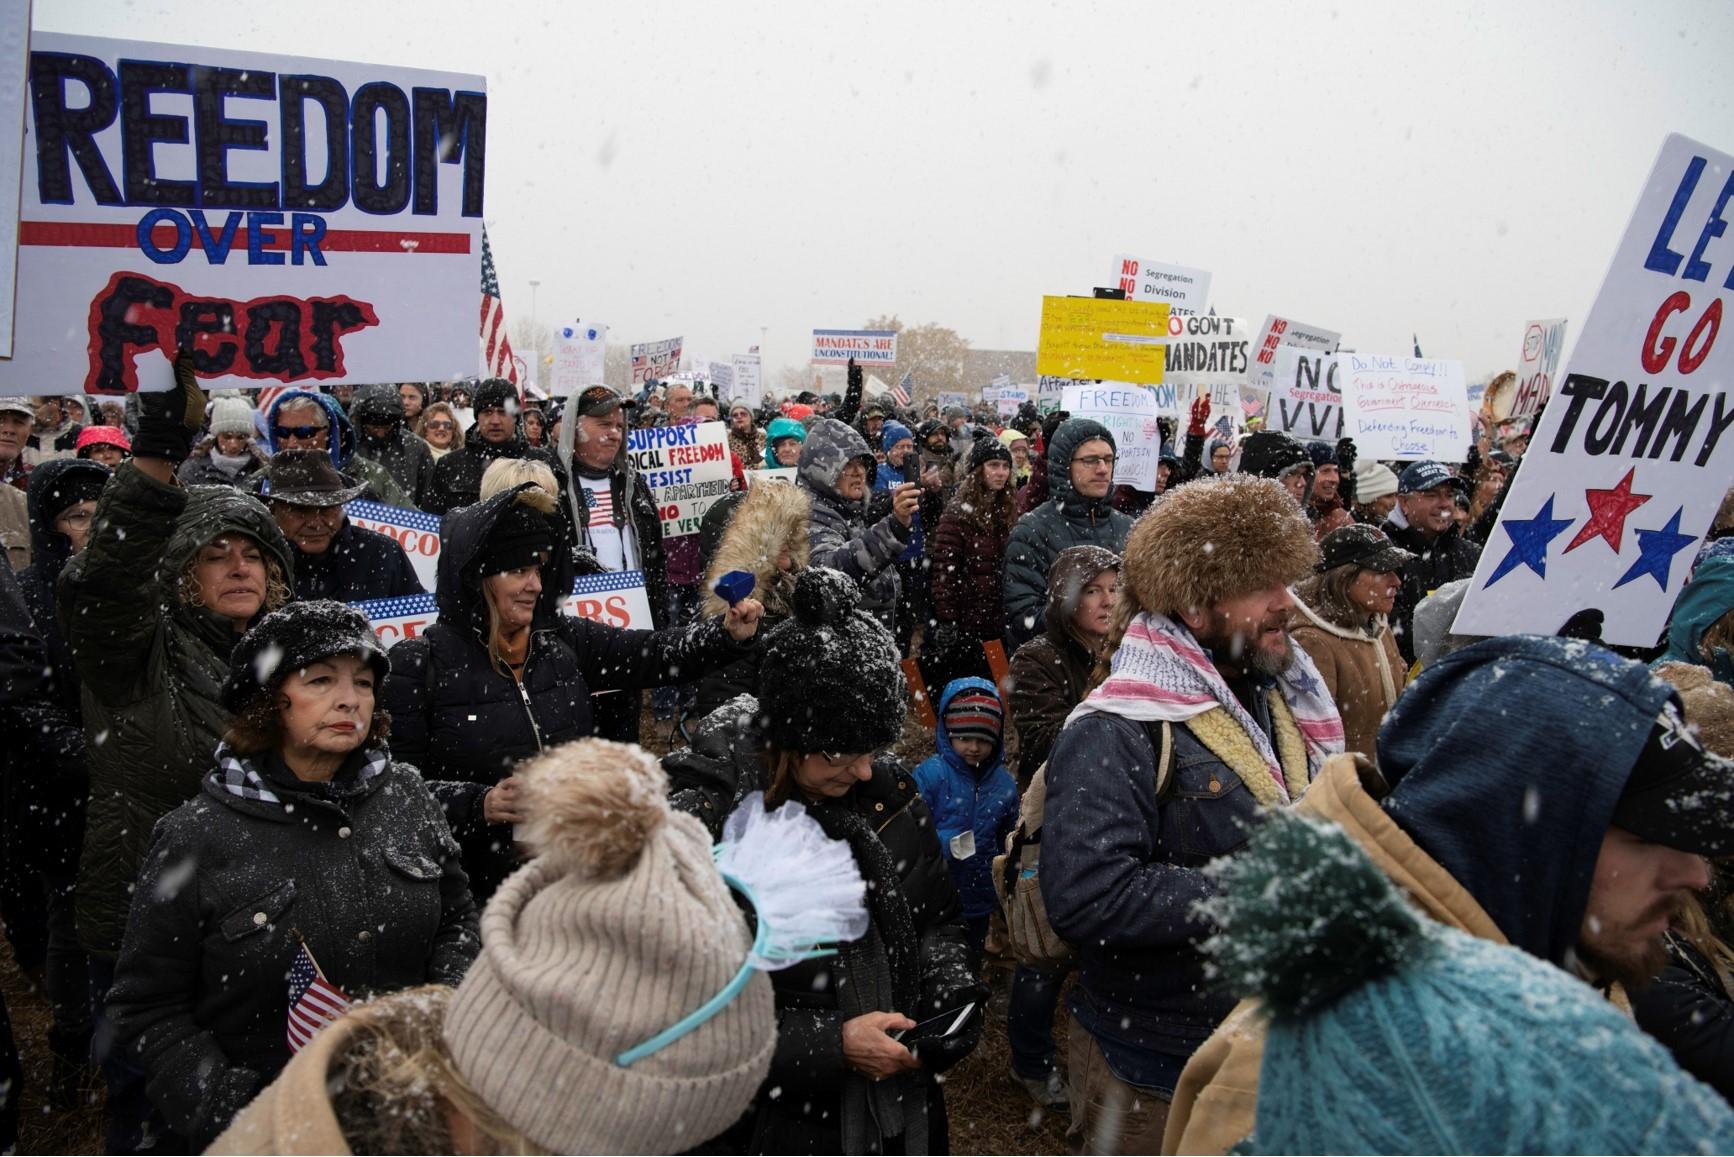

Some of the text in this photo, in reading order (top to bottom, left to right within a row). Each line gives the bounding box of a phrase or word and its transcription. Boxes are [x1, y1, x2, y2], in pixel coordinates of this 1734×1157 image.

[30, 51, 487, 217] REEDOM
[1643, 155, 1734, 290] LE
[136, 209, 327, 267] OVER
[1122, 259, 1193, 284] NO Segregation
[1120, 277, 1186, 299] NO Division
[85, 271, 379, 394] Fear
[1167, 316, 1183, 335] O
[1270, 318, 1331, 344] NO Segregation
[1641, 291, 1722, 374] GO
[815, 336, 893, 350] MANDATES ARE
[815, 348, 893, 360] UNCONSTITUTIONAL!
[1263, 334, 1280, 350] NO
[651, 353, 669, 364] NOT
[1257, 348, 1274, 364] NO
[1352, 356, 1367, 370] Do
[1372, 356, 1397, 370] Not
[1551, 374, 1734, 467] TOMMY
[627, 423, 698, 451] SUPPORT
[1122, 431, 1134, 443] NO
[628, 442, 725, 470] DICAL FREEDOM
[664, 479, 730, 503] APARTHEID
[691, 501, 707, 516] TO
